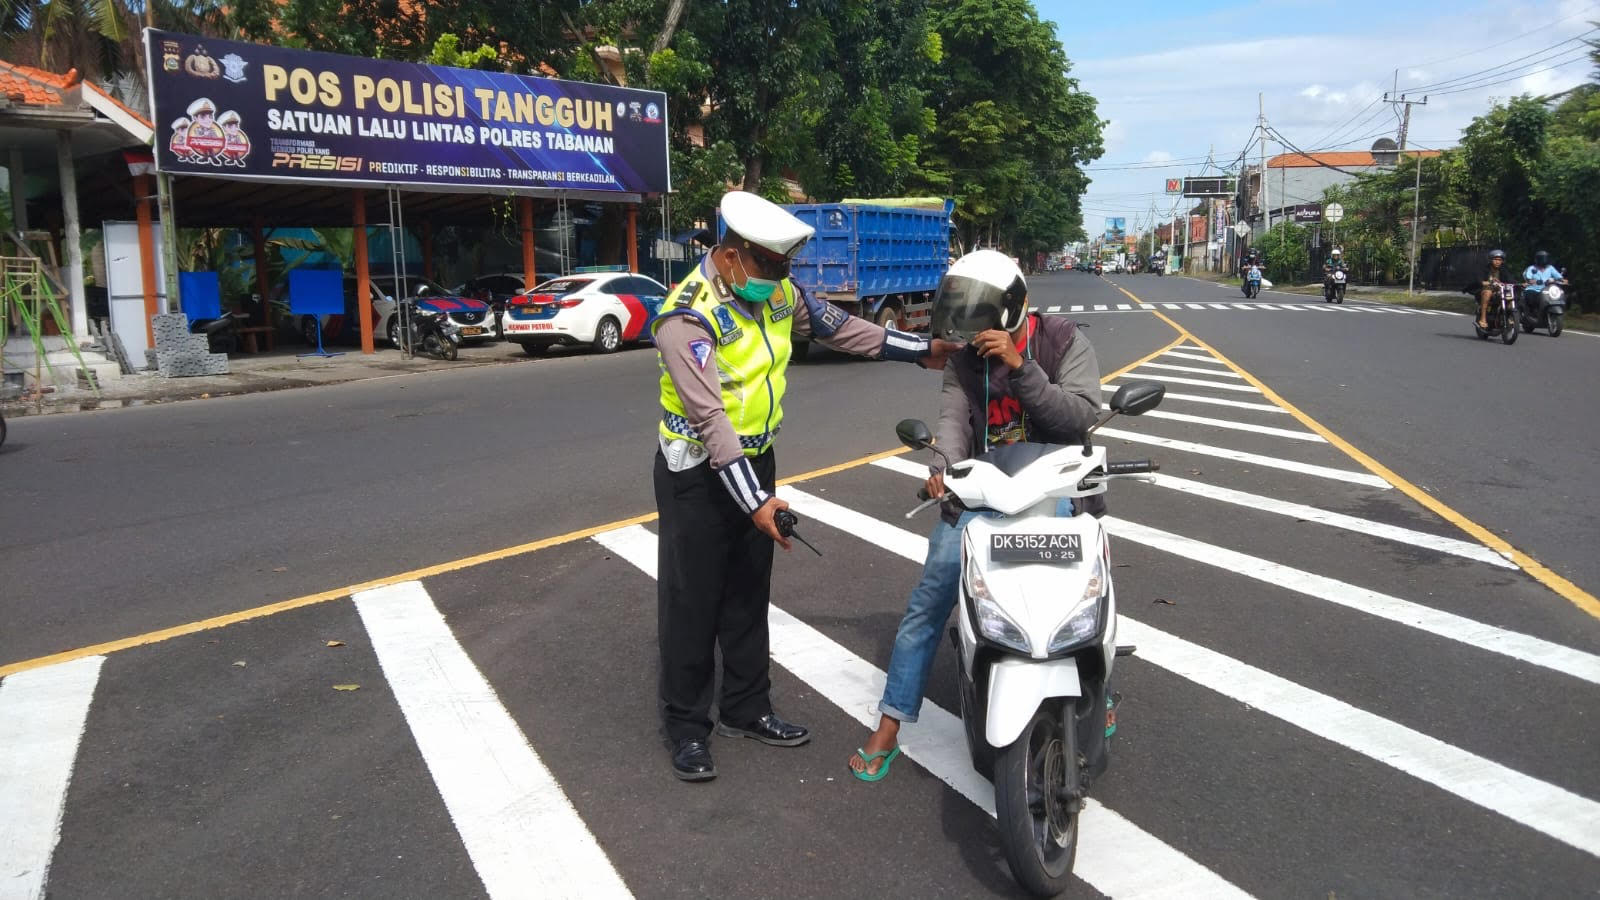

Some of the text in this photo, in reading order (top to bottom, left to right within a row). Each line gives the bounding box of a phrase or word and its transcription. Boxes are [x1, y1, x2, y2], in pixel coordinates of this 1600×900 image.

[263, 64, 613, 131] POS POLISI TANGGUH
[267, 108, 614, 154] SATUAN LALU LINTAS POLRES TABANAN
[272, 152, 363, 172] PRESISI
[369, 161, 418, 174] PREDIKTIF
[426, 164, 501, 178] RESPONSIBILITAS
[508, 169, 565, 181] TRANSPARANSI
[567, 172, 615, 184] BERKEADILAN
[994, 535, 1079, 549] DK 5152 ACN
[1039, 551, 1052, 559] 10
[1060, 551, 1075, 559] 25
